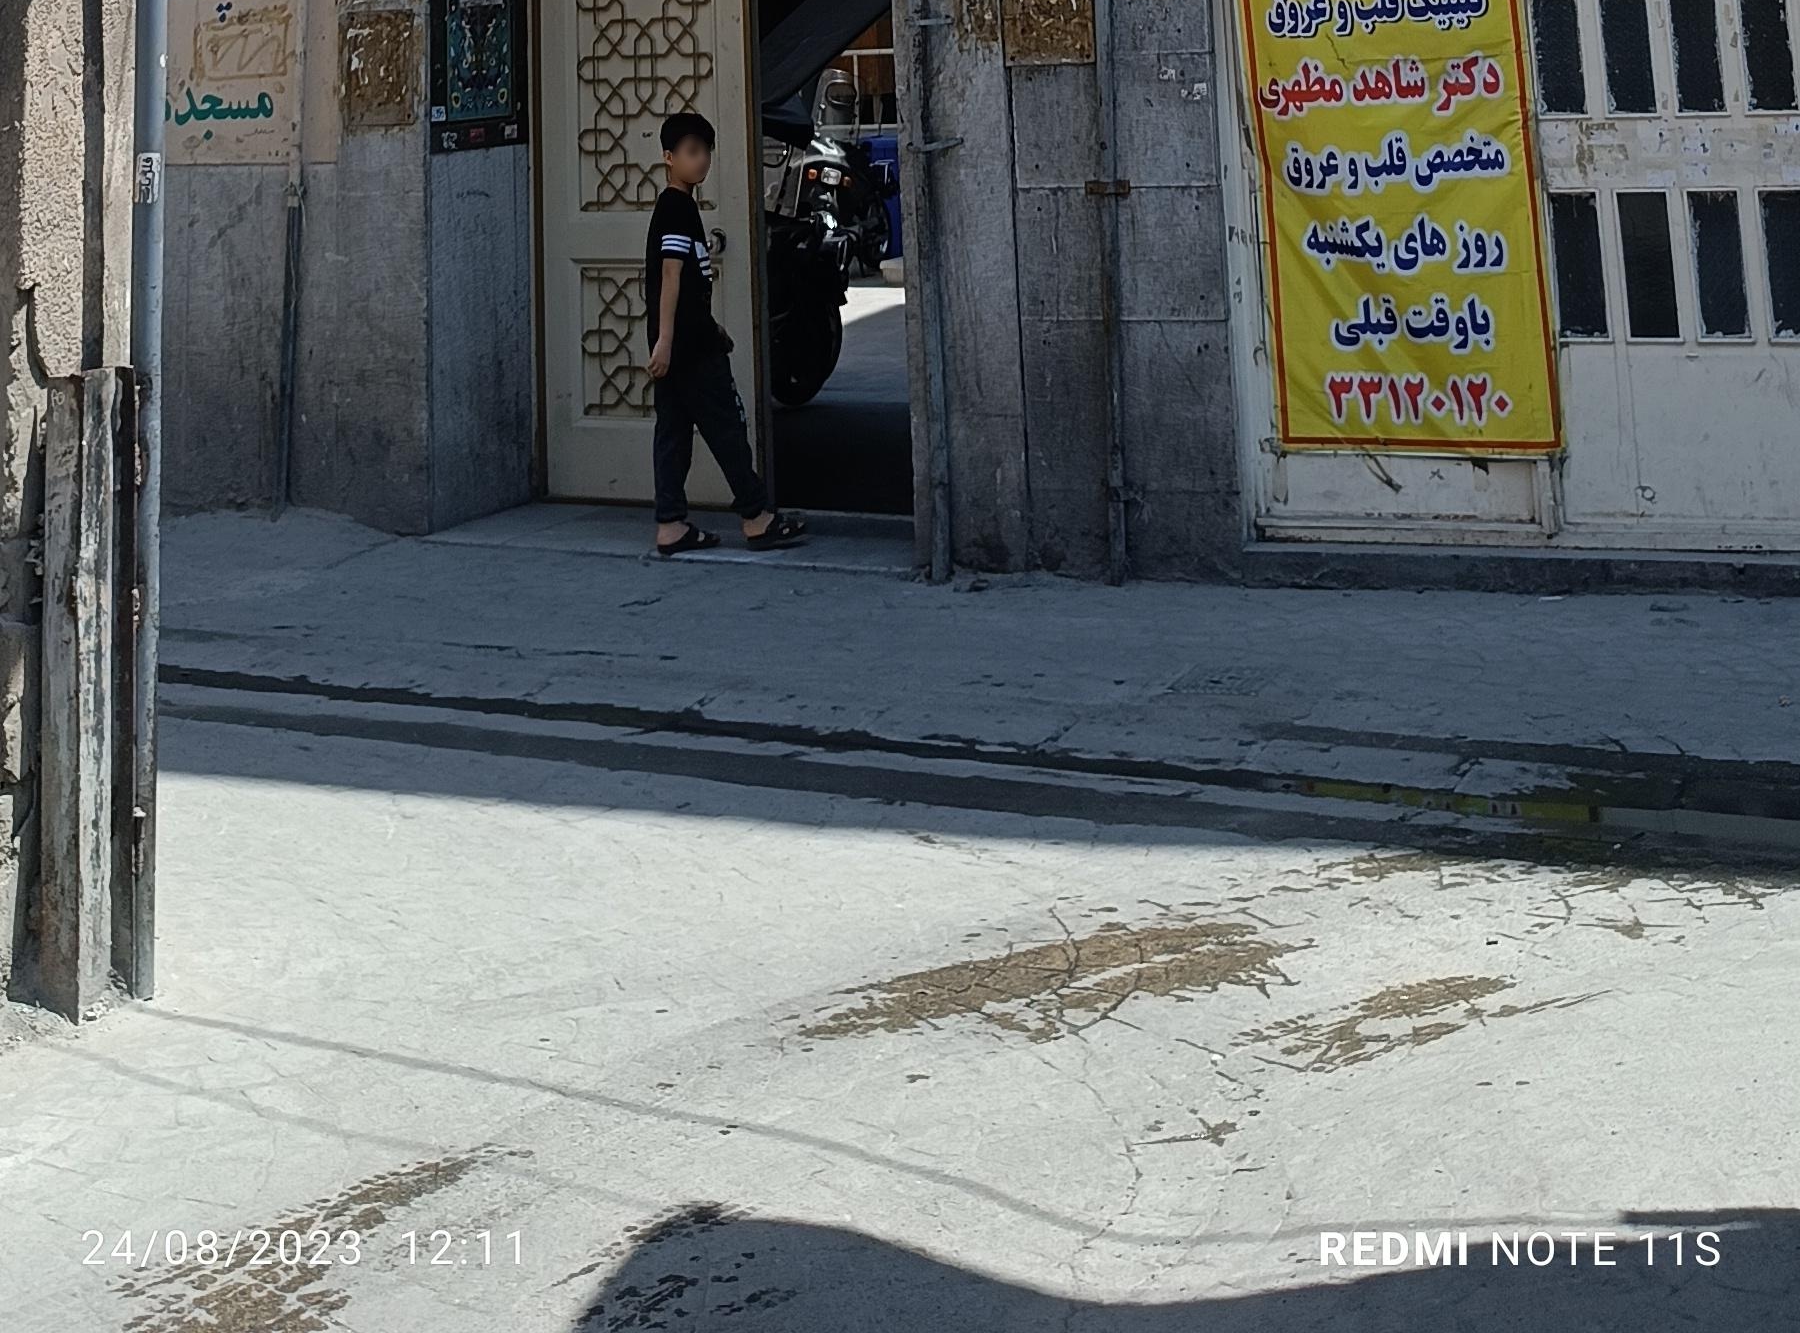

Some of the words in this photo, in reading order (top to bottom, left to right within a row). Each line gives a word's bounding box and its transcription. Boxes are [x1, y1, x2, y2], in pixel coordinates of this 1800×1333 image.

[1335, 4, 1349, 33] و
[1260, 64, 1344, 116] مظهری
[1353, 60, 1425, 102] شاهد
[1437, 56, 1500, 112] دکتر
[175, 87, 274, 140] مسجد
[1286, 146, 1339, 190] عروق
[1347, 157, 1359, 190] و
[1364, 136, 1407, 187] قلب
[1414, 135, 1506, 187] متخصص
[1306, 220, 1384, 269] یکشنبه
[1393, 217, 1447, 271] های
[1456, 224, 1505, 269] روز
[1334, 297, 1398, 347] قبلی
[1328, 375, 1510, 422] ۳۳۱۲۰۱۲۰
